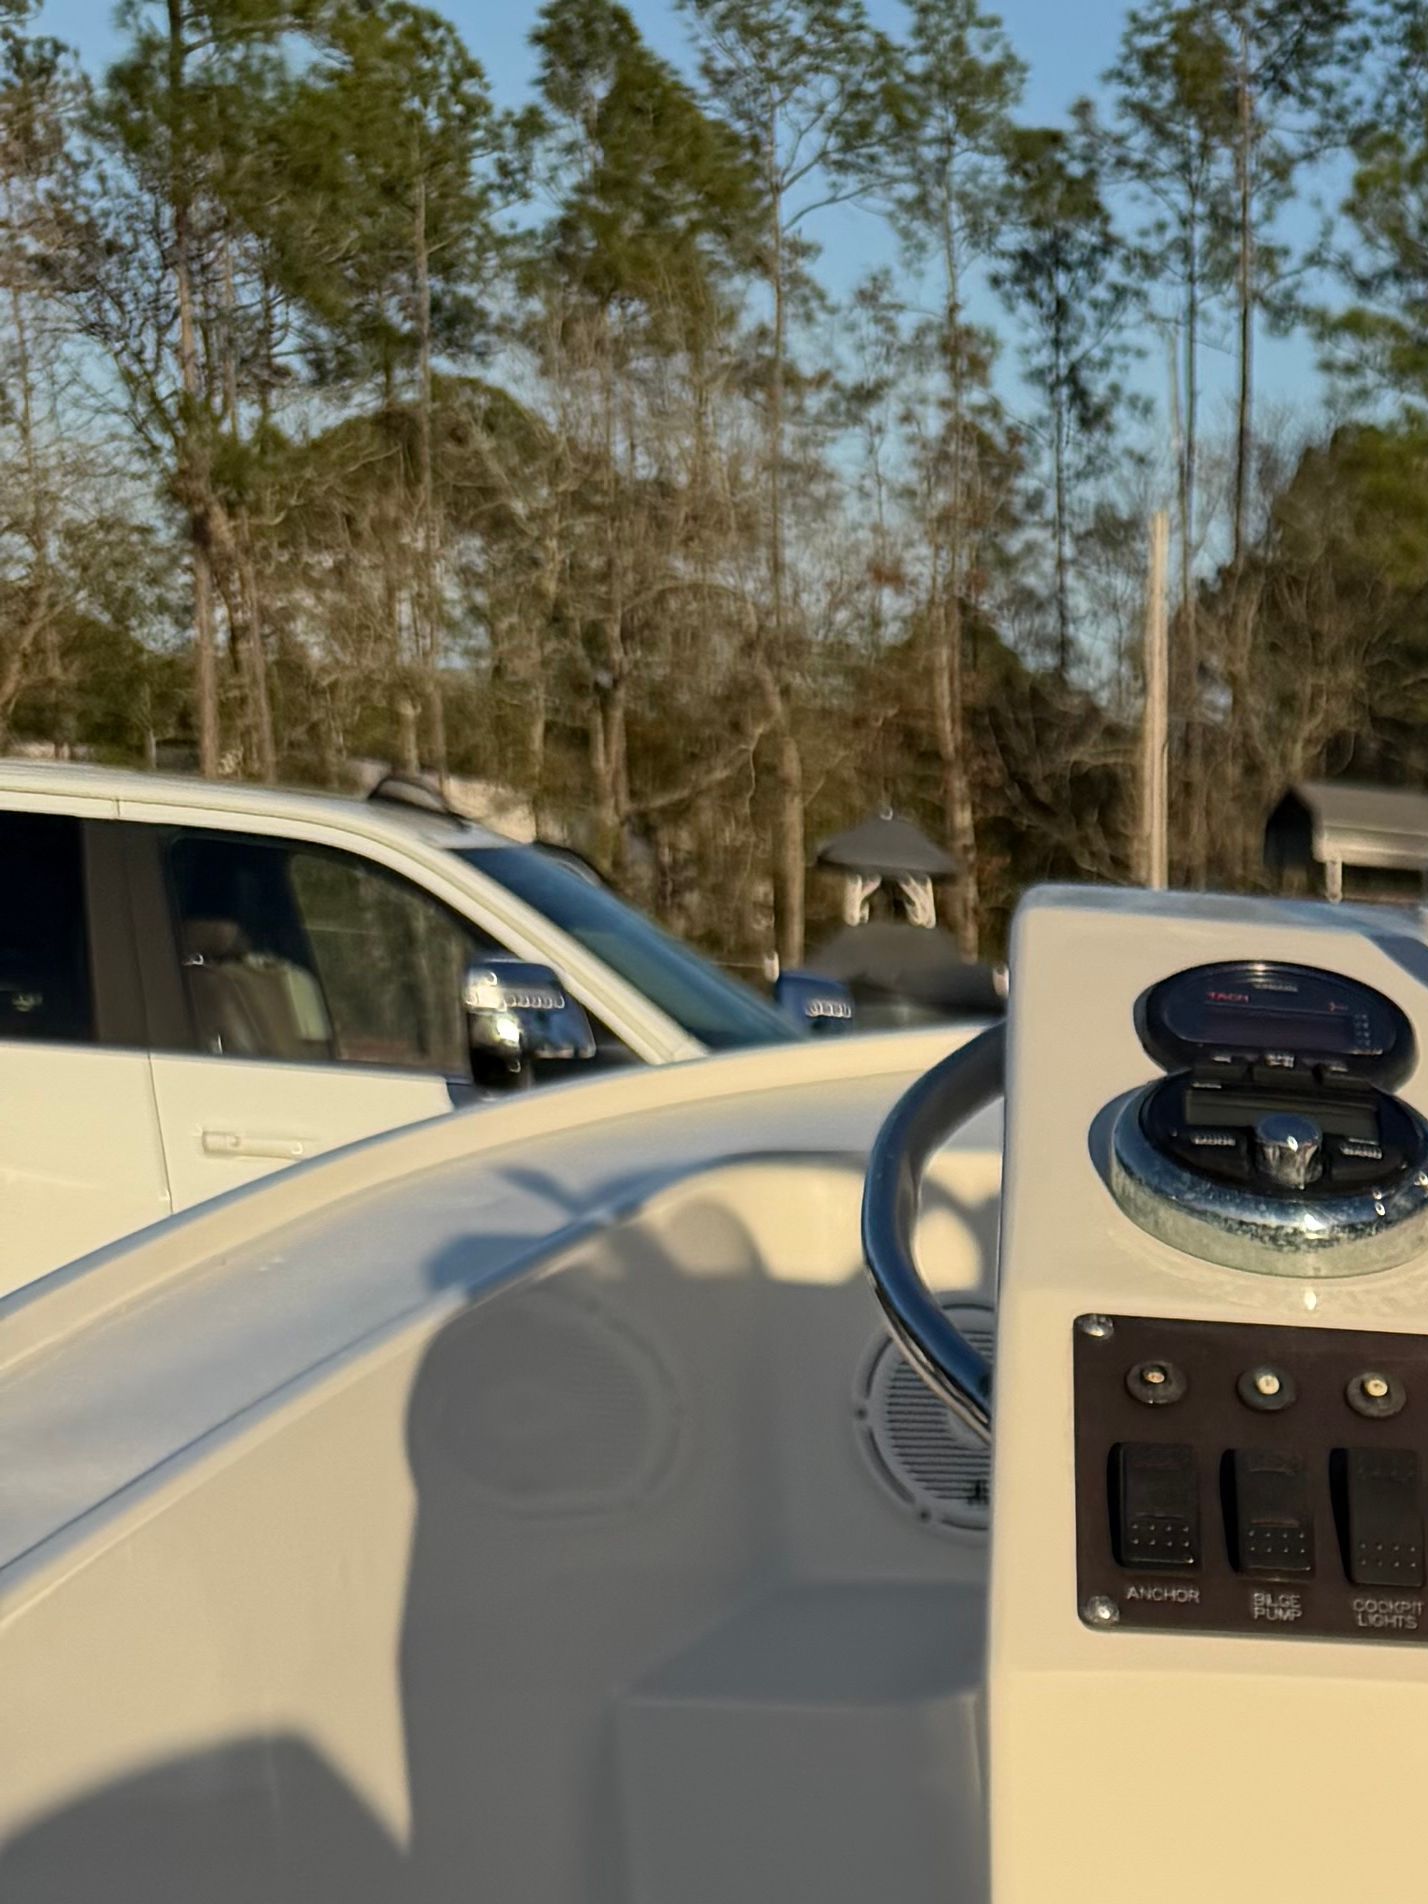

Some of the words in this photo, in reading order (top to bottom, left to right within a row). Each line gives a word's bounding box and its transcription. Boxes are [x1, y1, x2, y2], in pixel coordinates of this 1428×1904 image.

[1126, 1585, 1200, 1604] ANCHOR
[1253, 1592, 1302, 1608] BILGE
[1253, 1606, 1302, 1622] PUMP
[1352, 1598, 1425, 1616] COCKPIT
[1357, 1613, 1419, 1630] LIGHTS
